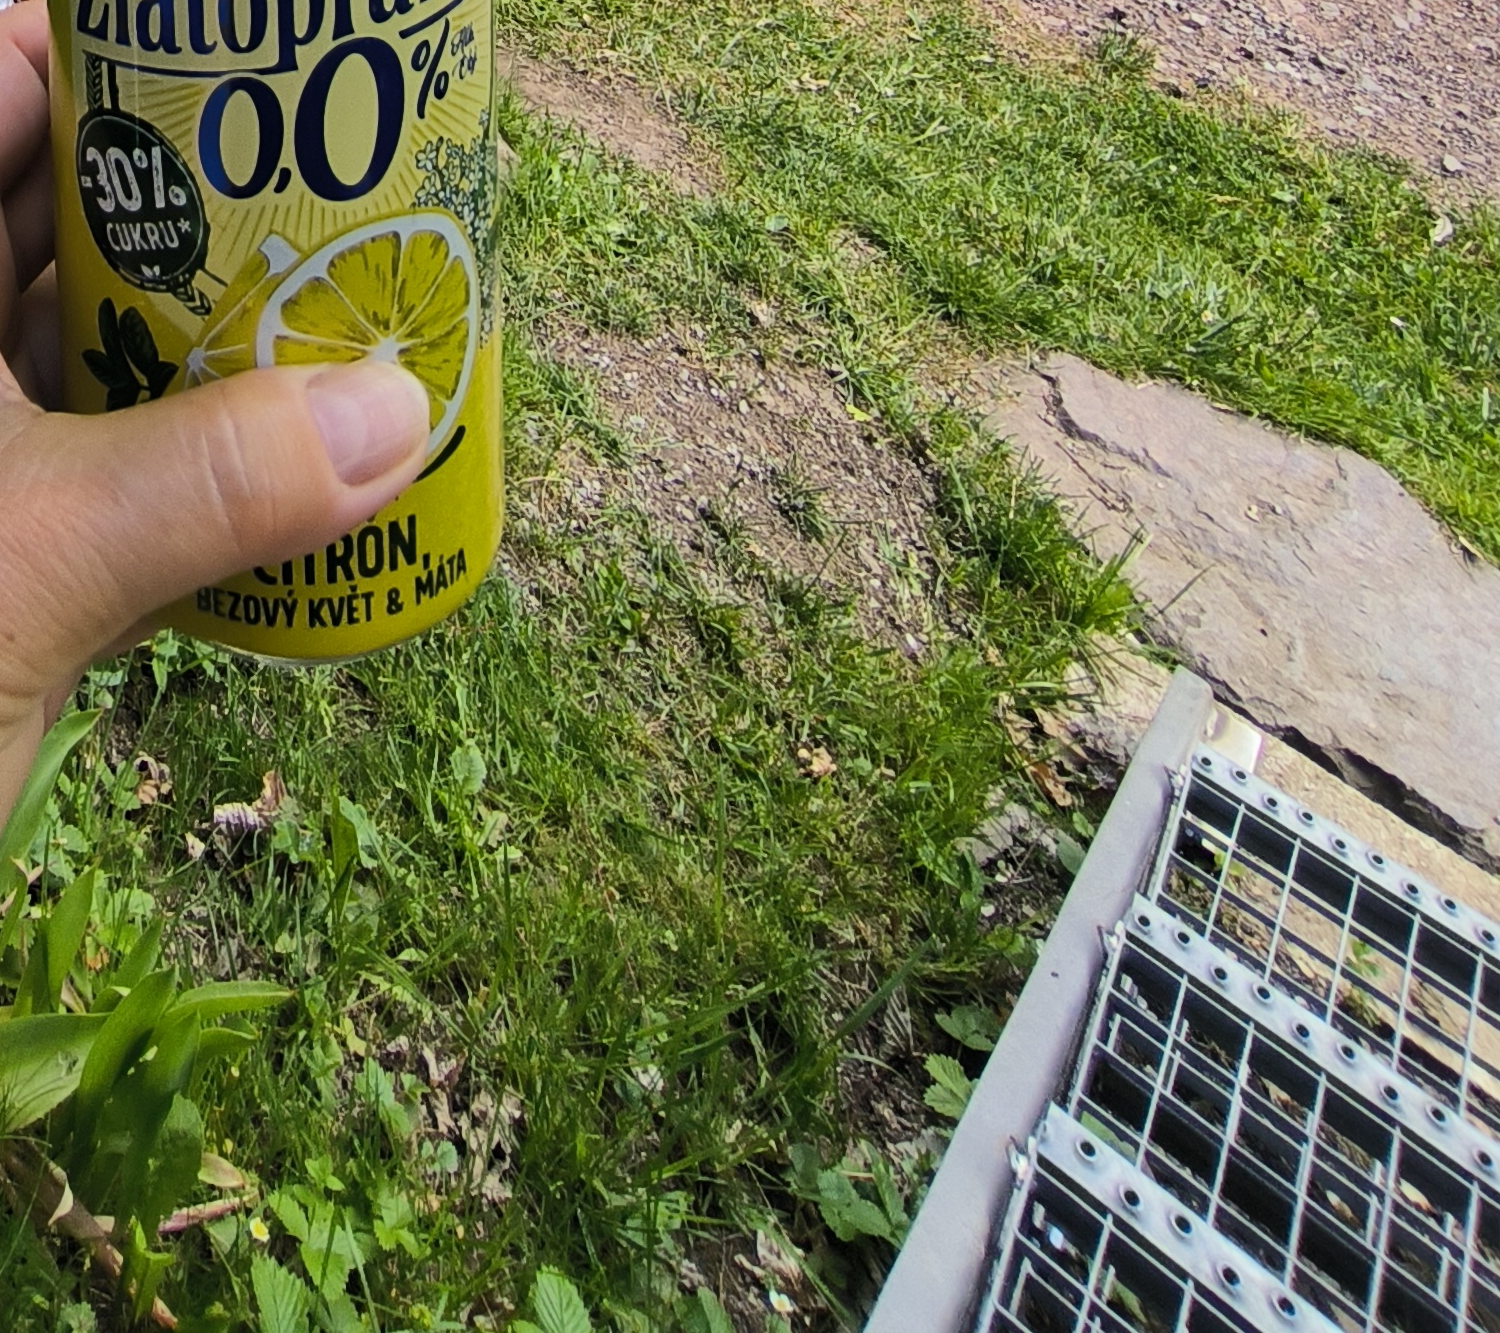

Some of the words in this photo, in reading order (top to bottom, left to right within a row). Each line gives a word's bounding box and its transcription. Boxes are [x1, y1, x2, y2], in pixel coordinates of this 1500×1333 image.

[81, 145, 187, 212] -30%
[196, 586, 299, 628] BEZOVÝ
[308, 585, 374, 629] KVĚT
[386, 587, 404, 616] &
[414, 548, 468, 606] MÁTA
